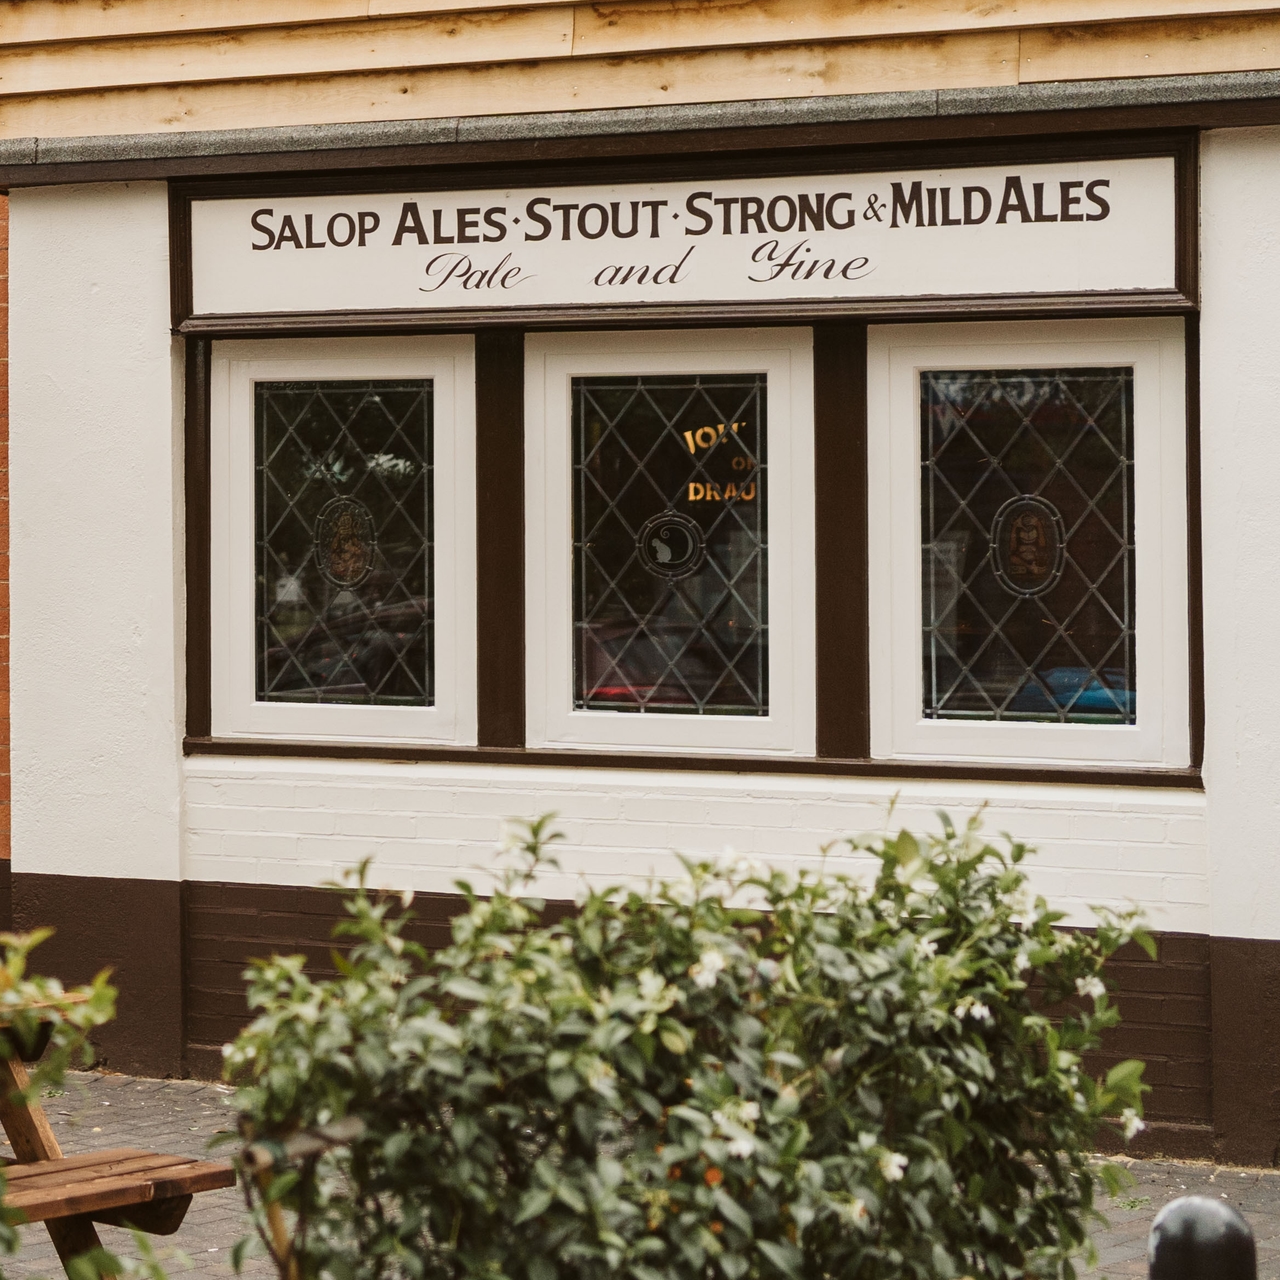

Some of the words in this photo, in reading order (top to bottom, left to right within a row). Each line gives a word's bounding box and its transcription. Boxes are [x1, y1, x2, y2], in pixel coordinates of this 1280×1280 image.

[250, 208, 381, 251] SALOP
[391, 201, 508, 246] ALES
[524, 196, 669, 242] STOUT
[684, 191, 856, 236] STRONG
[862, 193, 887, 223] &
[889, 180, 992, 229] MILD
[995, 175, 1111, 225] ALES
[418, 251, 538, 293] Pale
[592, 245, 697, 287] and
[747, 238, 874, 283] Fine
